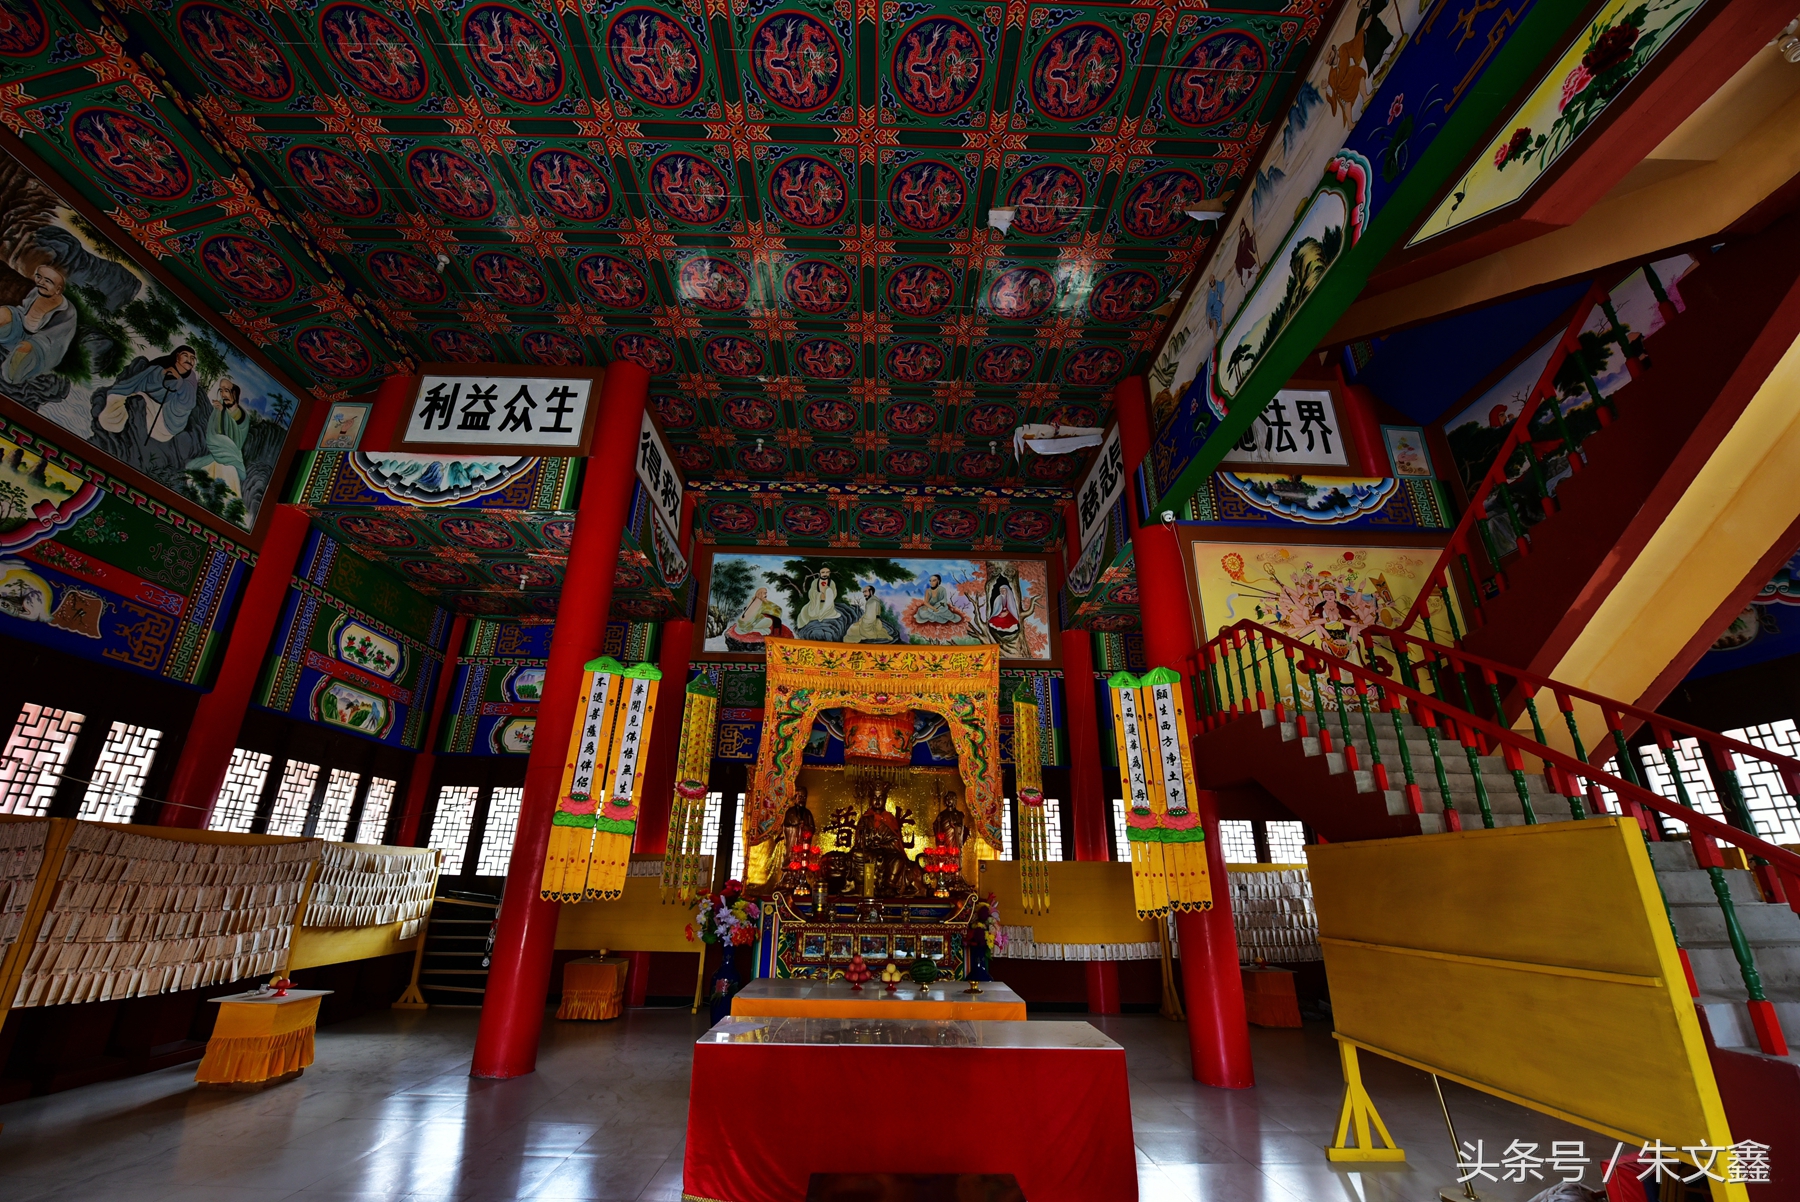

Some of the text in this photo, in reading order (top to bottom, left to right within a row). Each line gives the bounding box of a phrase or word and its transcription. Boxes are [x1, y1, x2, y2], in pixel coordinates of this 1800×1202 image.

[418, 382, 579, 433] 利益众生
[1080, 436, 1124, 538] 慈悲
